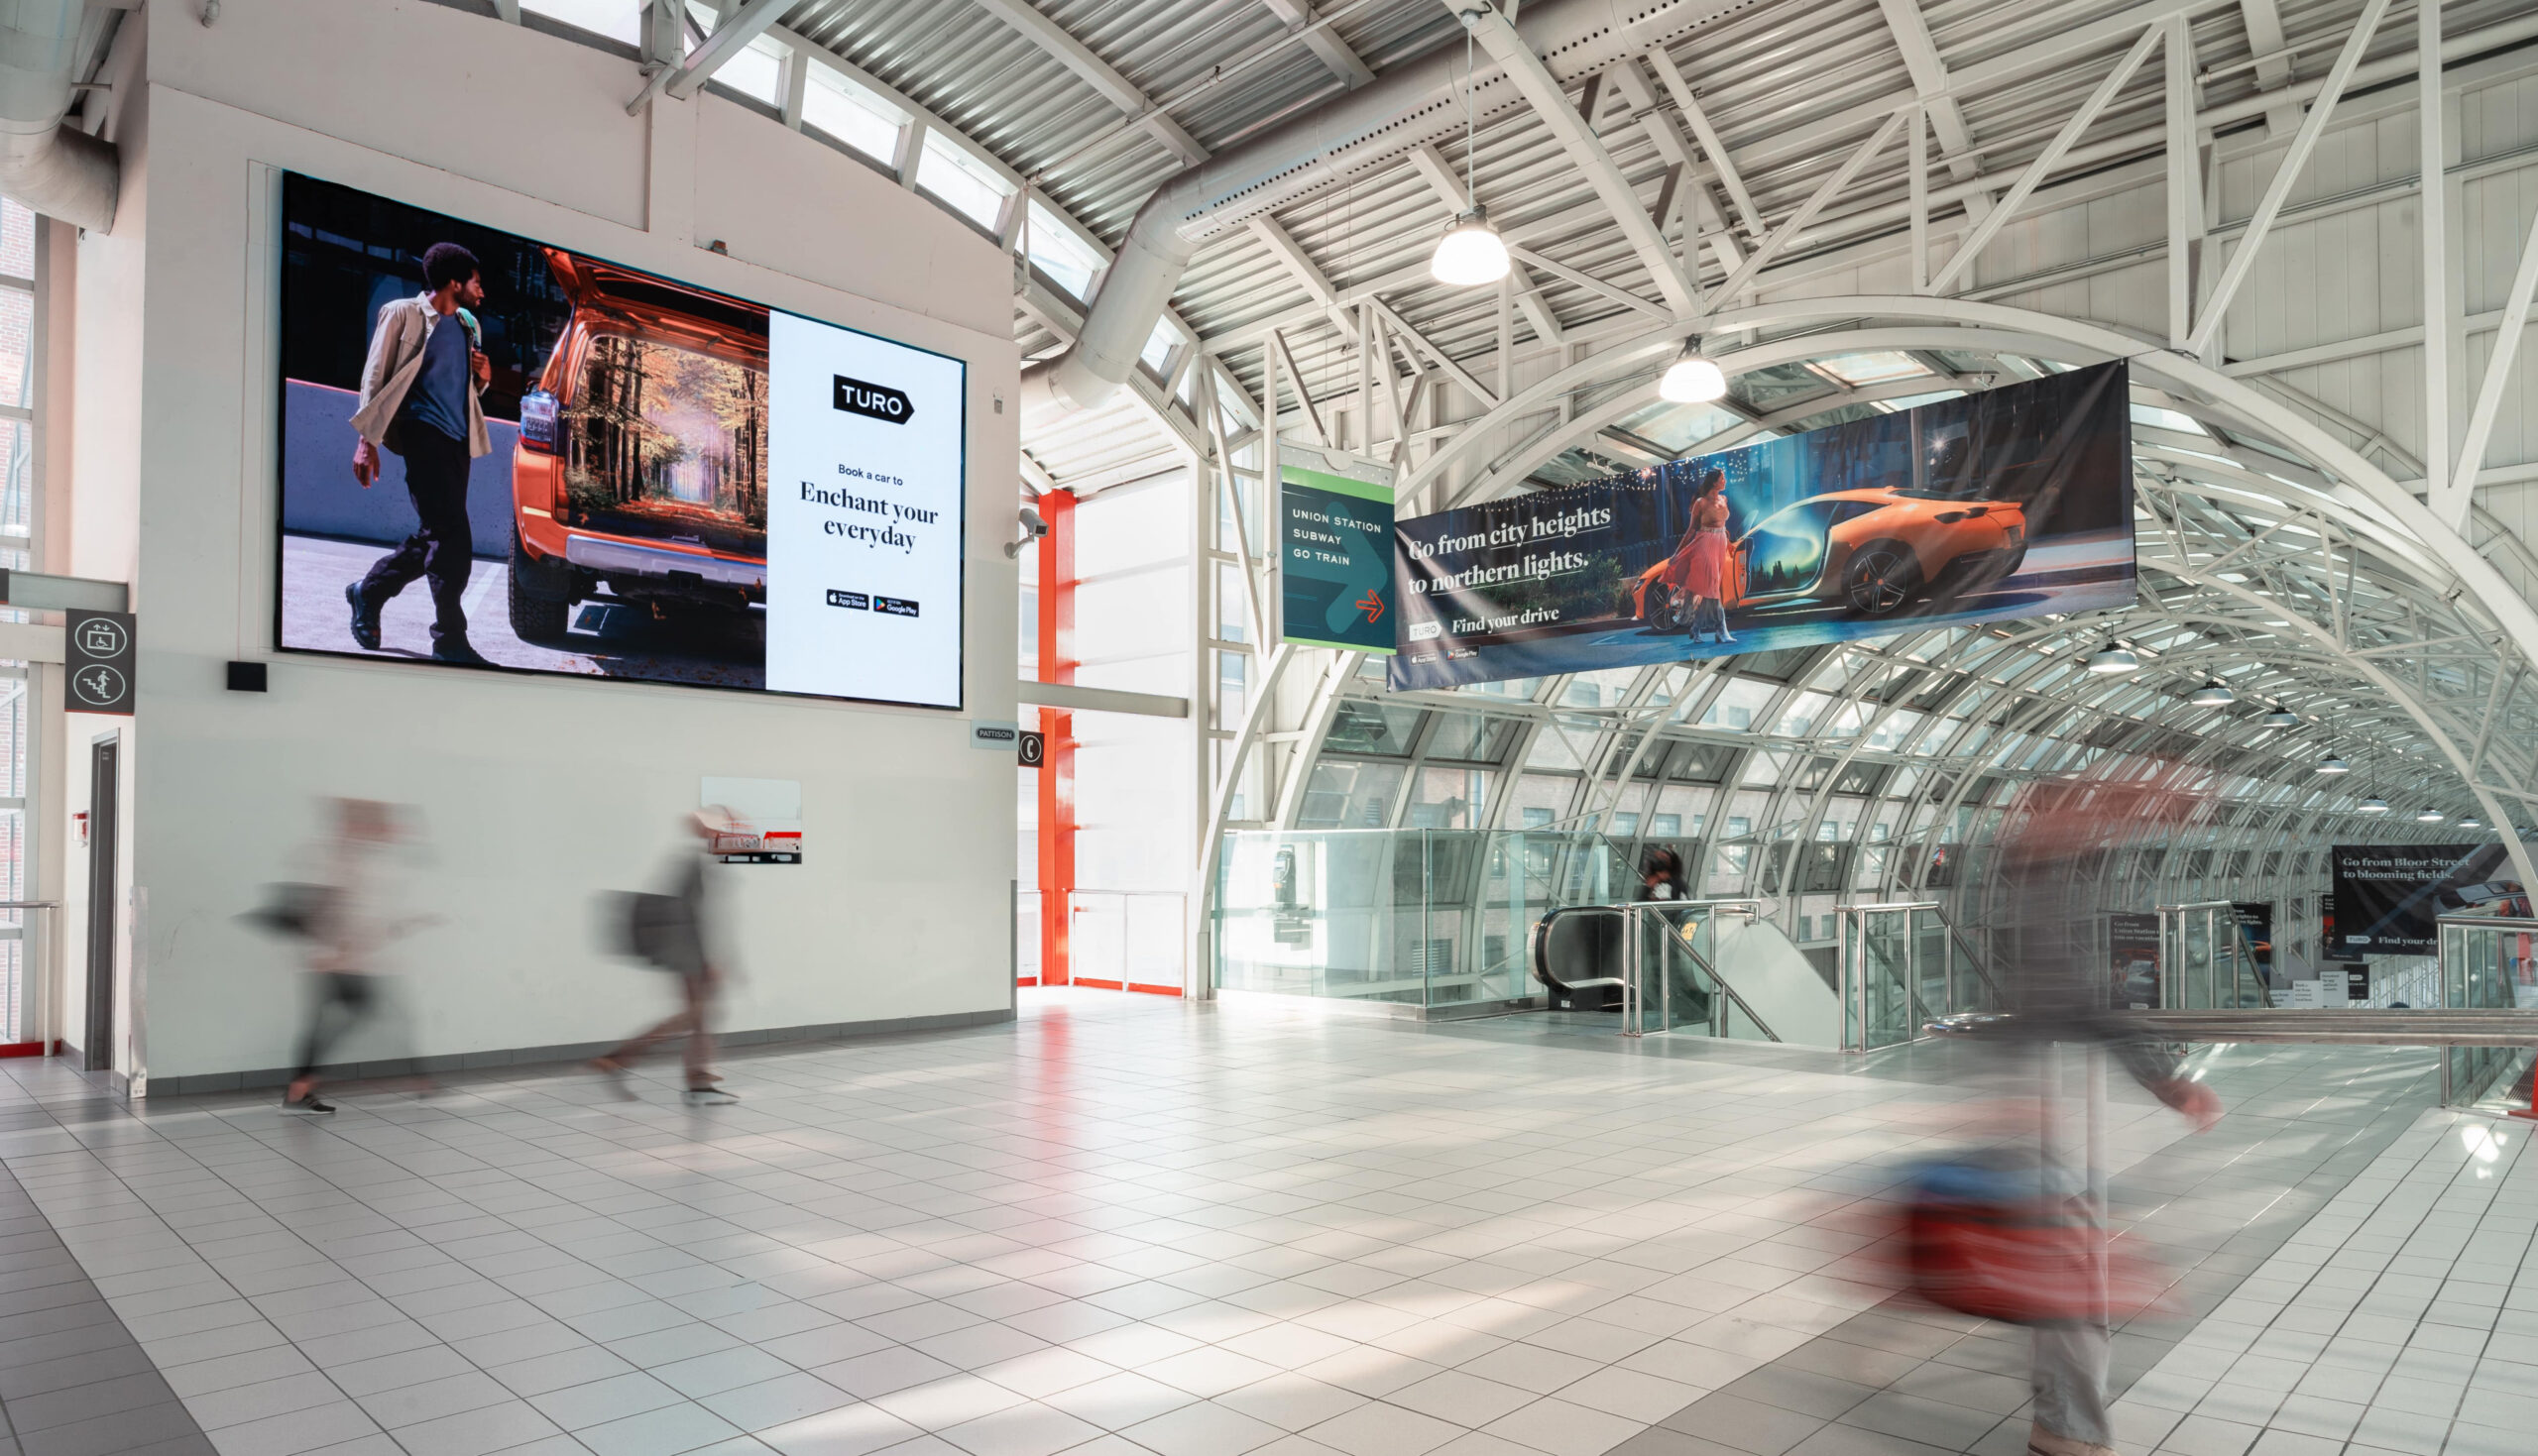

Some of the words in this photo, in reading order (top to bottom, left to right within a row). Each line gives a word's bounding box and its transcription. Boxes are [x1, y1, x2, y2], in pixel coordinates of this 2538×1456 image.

[842, 385, 903, 415] TURO
[838, 463, 864, 479] Book
[874, 473, 890, 484] car
[893, 476, 903, 486] to
[799, 480, 889, 515] Enchant
[892, 503, 939, 524] your
[1292, 508, 1329, 523] UNION
[1333, 516, 1381, 533] STATION
[824, 519, 917, 555] everyday
[1293, 528, 1341, 545] SUBWAY
[1408, 540, 1434, 560] Go
[1438, 532, 1486, 555] from
[1489, 522, 1529, 547] city
[1532, 507, 1611, 538] heights
[1293, 548, 1311, 559] GO
[1315, 551, 1350, 566] TRAIN
[1408, 579, 1427, 595] to
[1431, 563, 1520, 592] northern
[1523, 550, 1589, 580] lights.
[838, 598, 851, 607] App
[851, 599, 866, 608] Store
[886, 604, 905, 615] Google
[906, 607, 917, 616] Play
[1413, 625, 1437, 636] TURO
[1451, 616, 1485, 633] Find
[1486, 613, 1518, 634] your
[1520, 607, 1559, 625] drive
[980, 729, 1012, 738] PATTISON
[2343, 857, 2360, 866] Go
[2362, 857, 2392, 866] from
[2395, 857, 2428, 867] Bloor
[2431, 857, 2470, 866] Street
[2358, 869, 2415, 881] blooming
[2417, 869, 2454, 879] fields.
